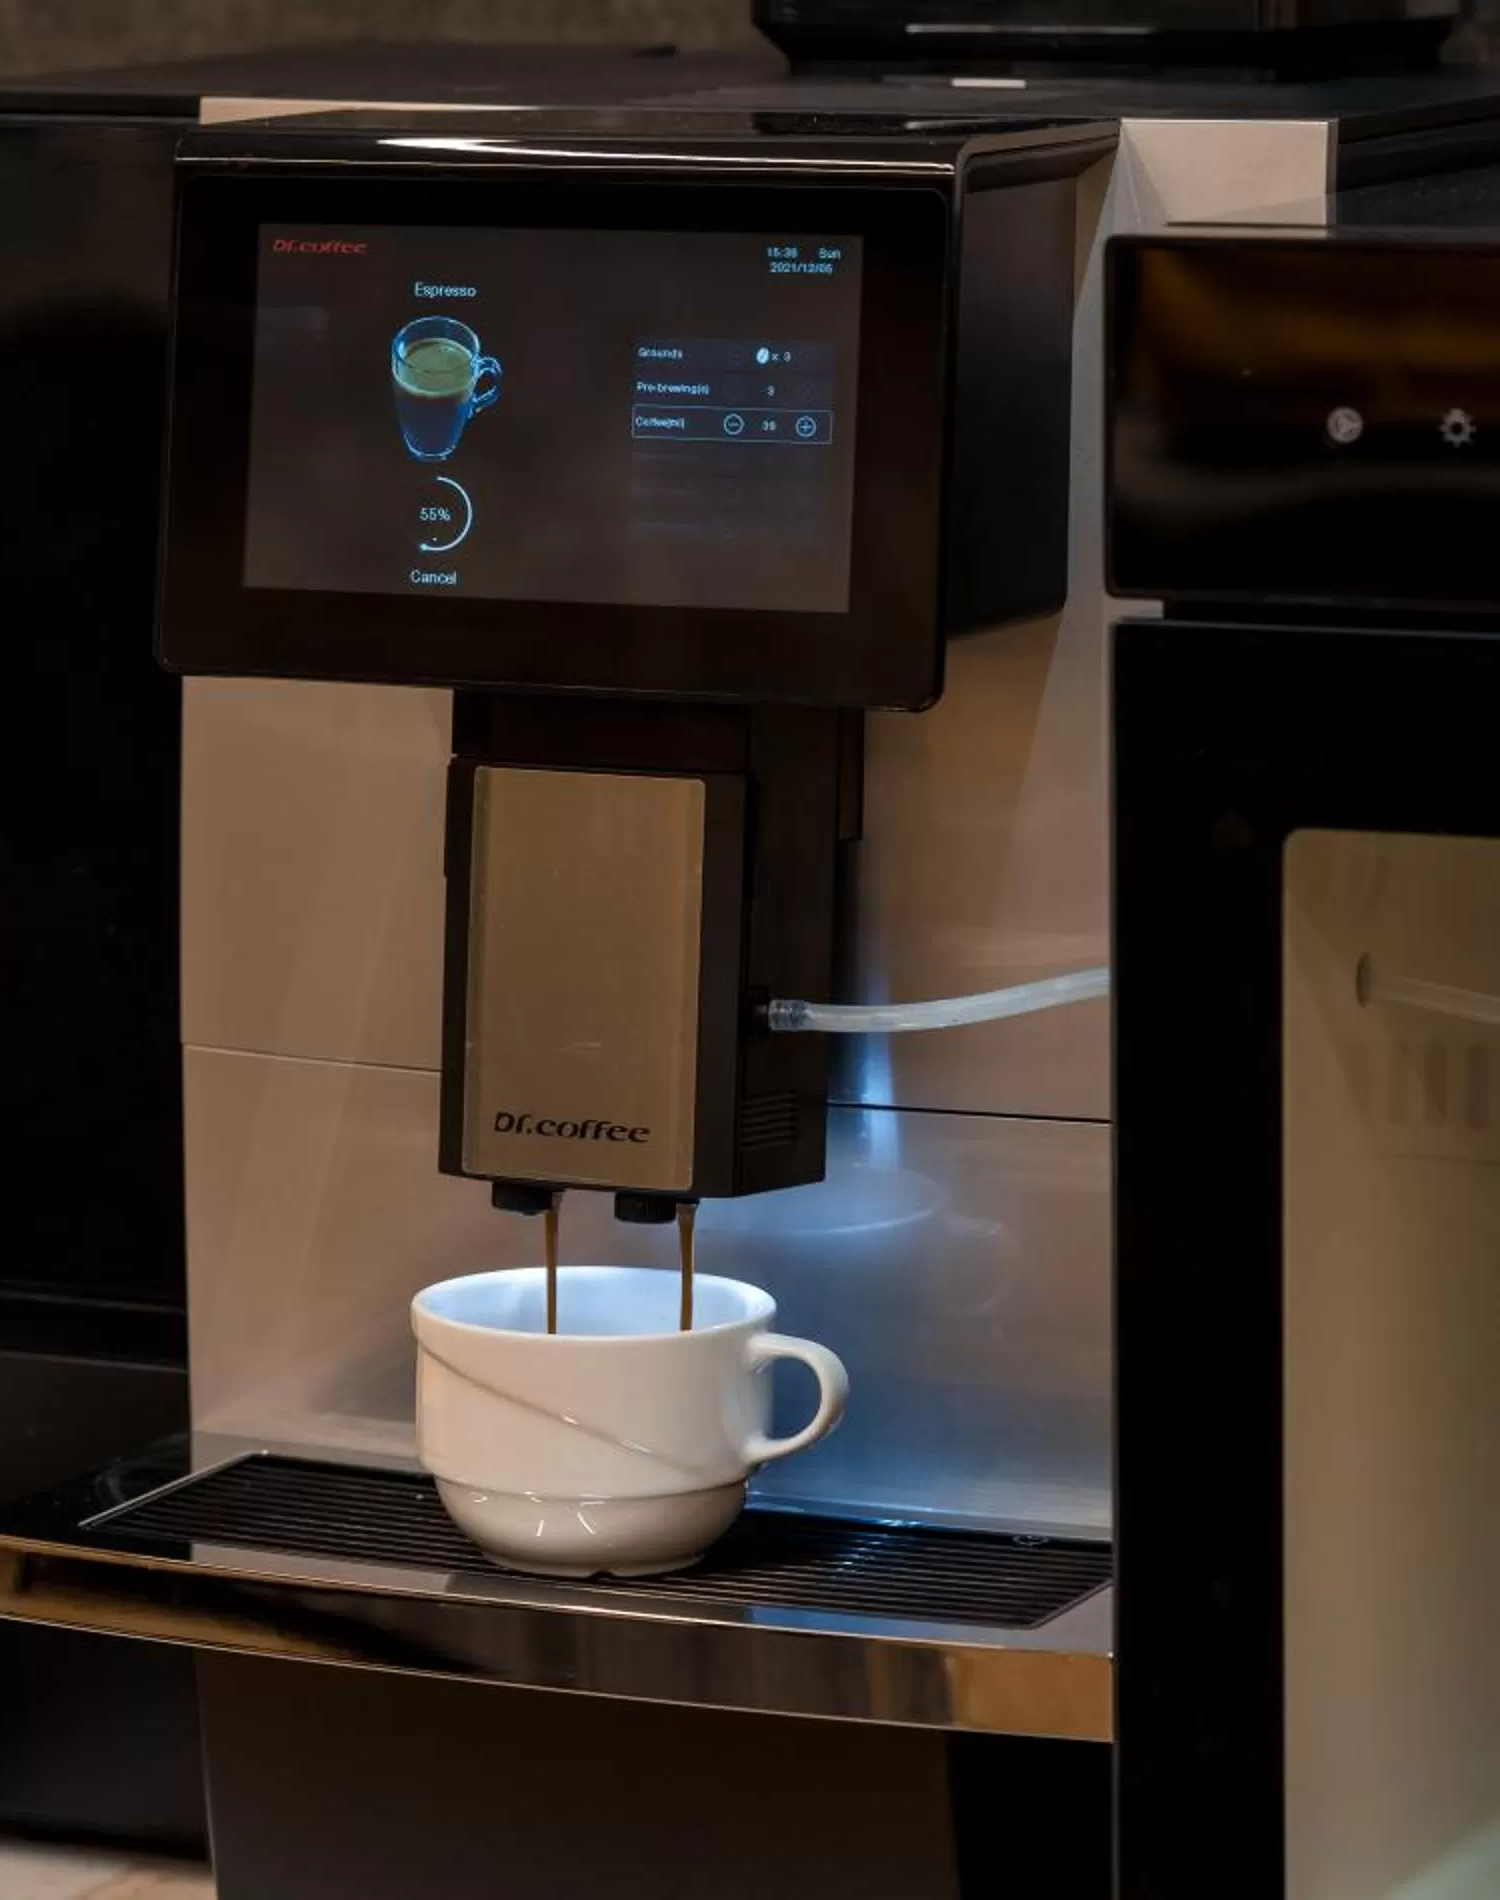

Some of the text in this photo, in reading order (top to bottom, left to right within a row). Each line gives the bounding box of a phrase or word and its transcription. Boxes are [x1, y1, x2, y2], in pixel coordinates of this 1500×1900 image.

[819, 248, 841, 260] Sun
[414, 281, 477, 299] Espresso
[420, 507, 451, 521] 55%
[410, 569, 457, 585] Cancel
[494, 1111, 651, 1143] Dr.coffee
